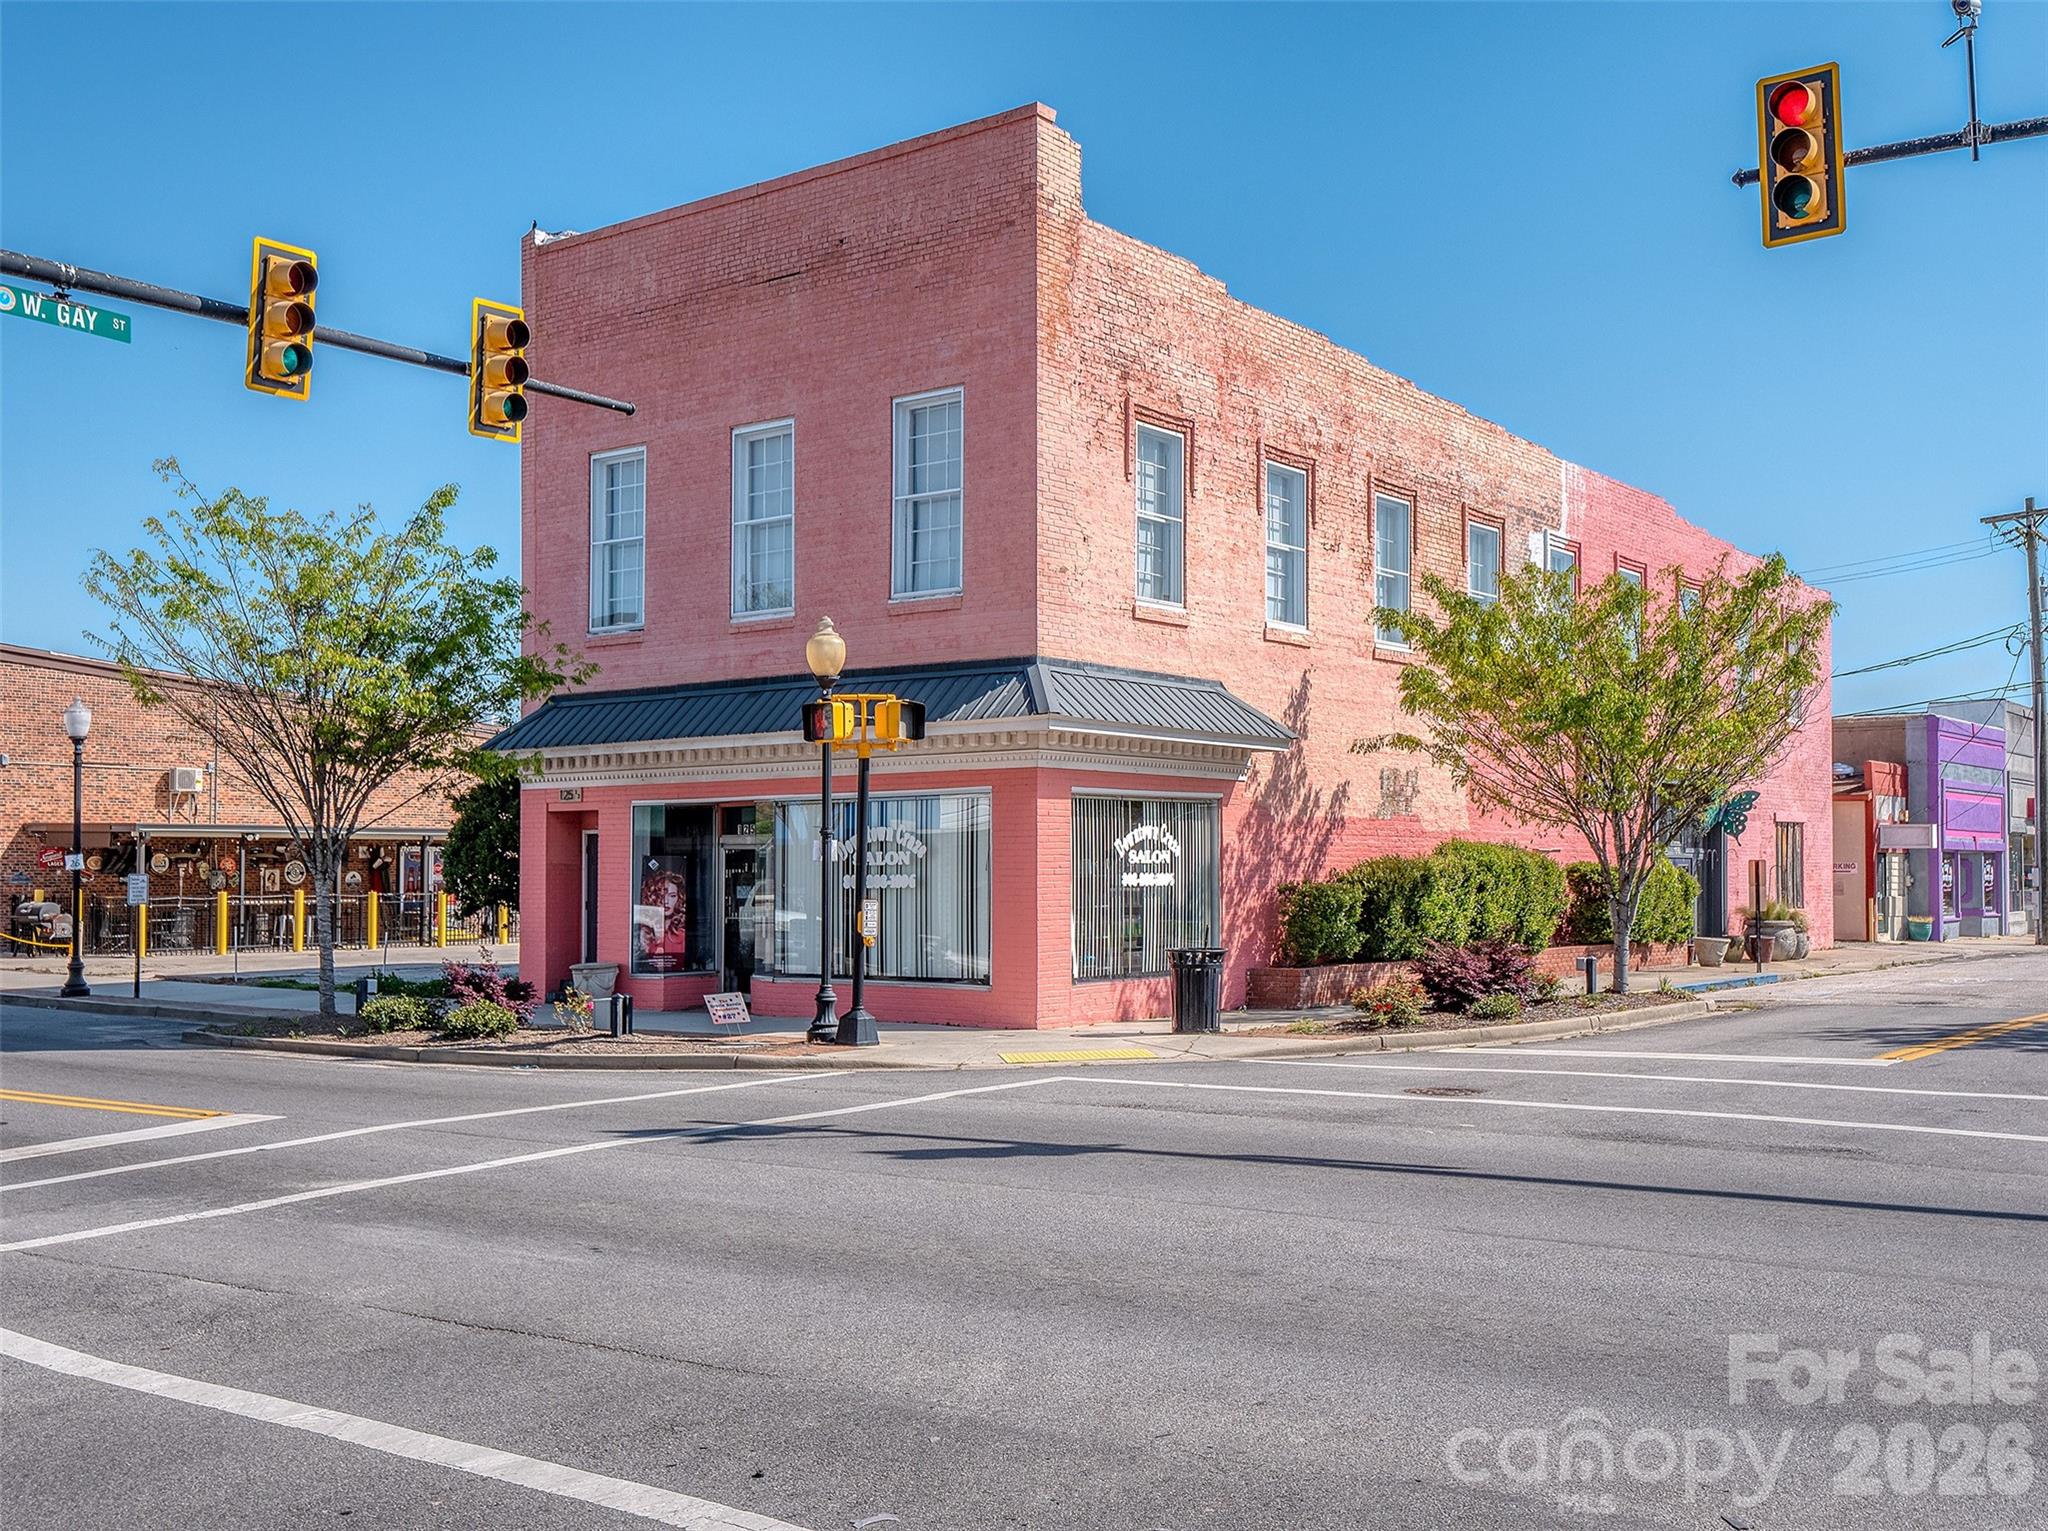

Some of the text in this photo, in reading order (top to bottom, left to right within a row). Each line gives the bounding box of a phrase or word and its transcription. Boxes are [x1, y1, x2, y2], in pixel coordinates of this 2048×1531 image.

[21, 293, 126, 331] W. GAY ST
[737, 824, 756, 835] 125
[836, 825, 895, 861] Dotown
[1128, 849, 1171, 864] SALON
